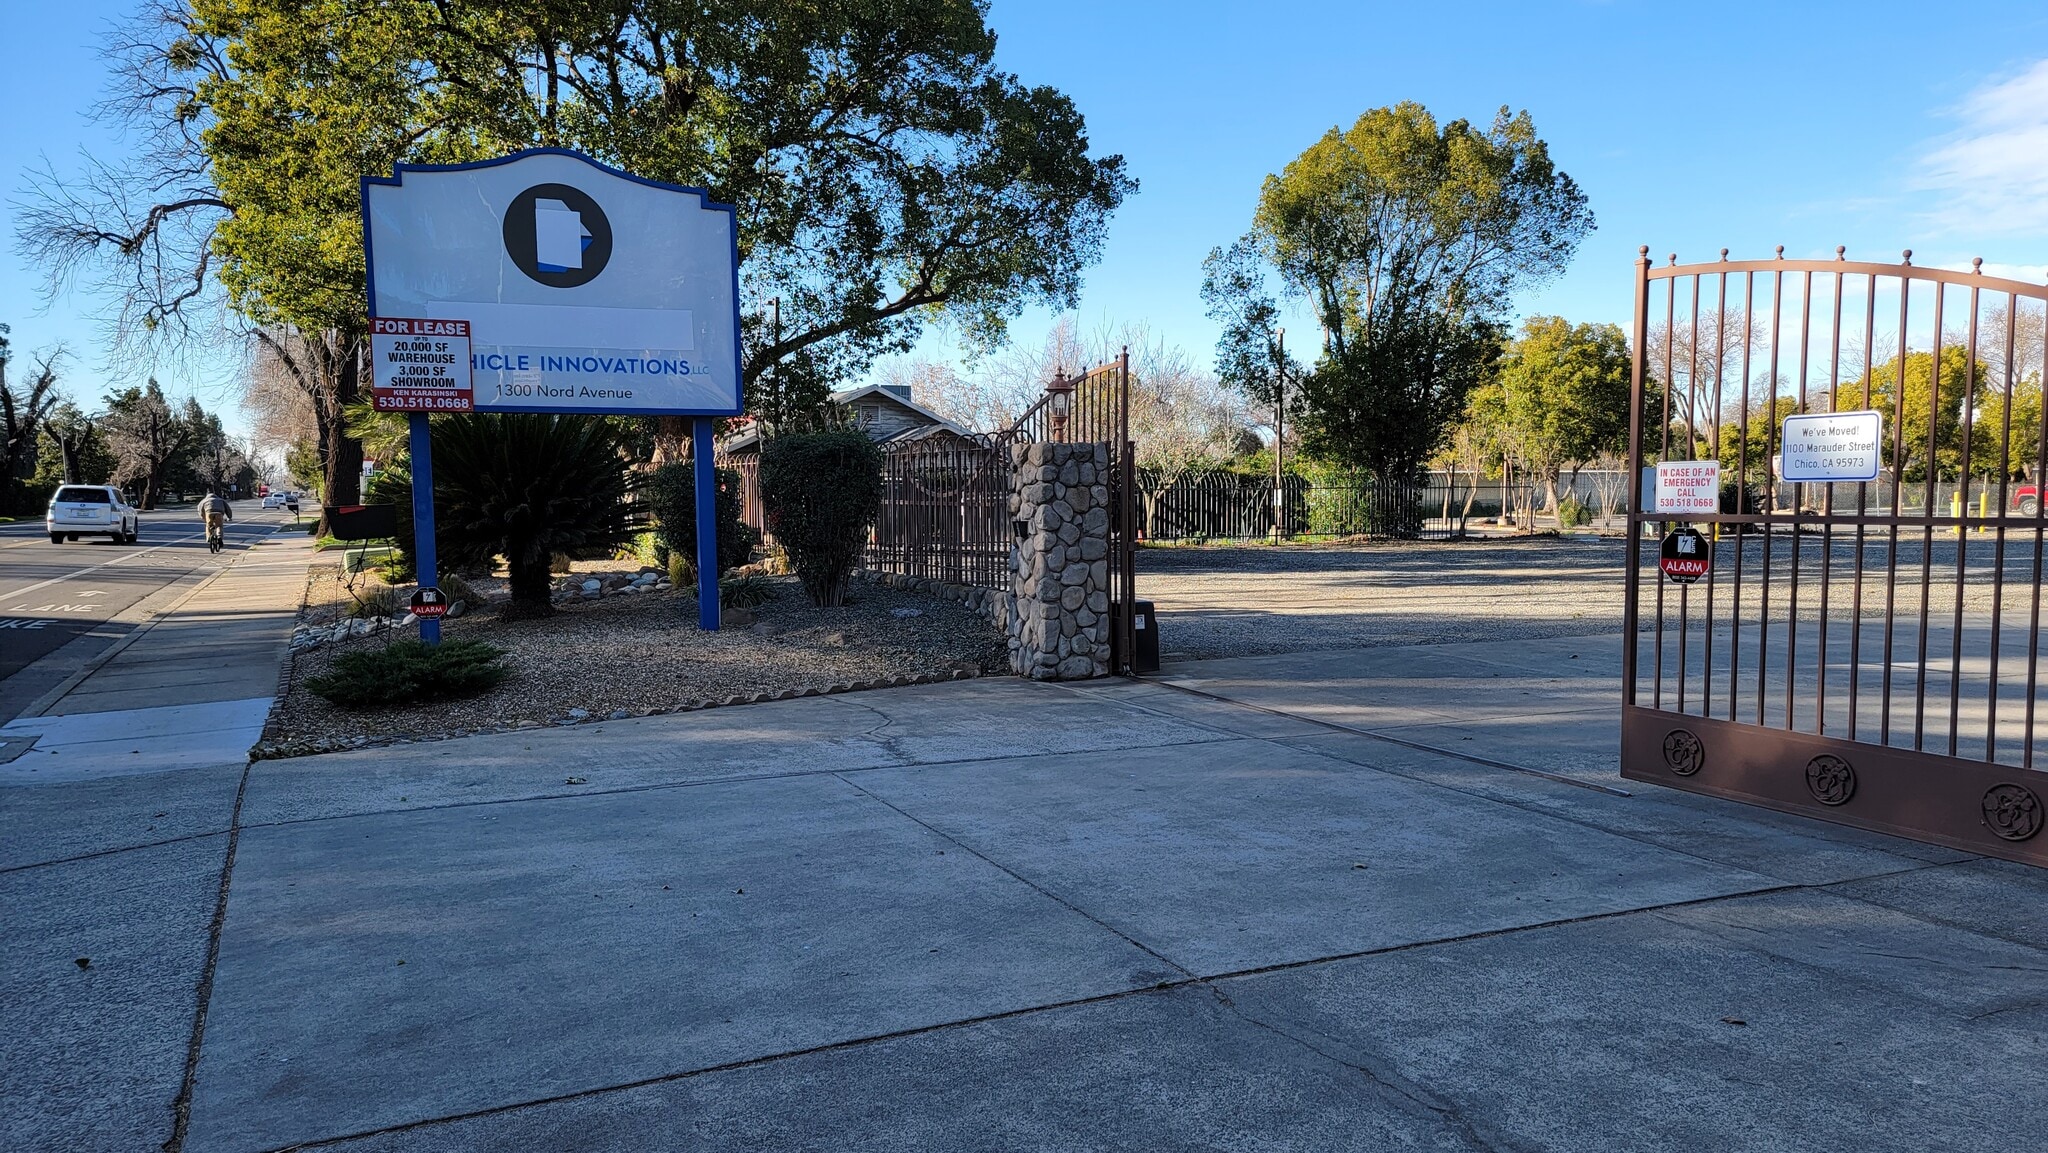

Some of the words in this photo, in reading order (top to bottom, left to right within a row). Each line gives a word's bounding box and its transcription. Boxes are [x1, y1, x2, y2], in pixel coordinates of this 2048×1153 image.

[375, 320, 409, 333] FOR
[414, 322, 466, 335] LEASE
[394, 341, 432, 352] 20,000
[435, 342, 448, 352] SF
[388, 352, 456, 364] WAREHOUSE
[399, 365, 430, 376] 3,000
[433, 366, 446, 376] SF
[391, 376, 455, 388] SHOWROOM
[495, 384, 532, 397] 1300
[537, 385, 574, 398] Nord
[579, 386, 633, 399] Avenue
[379, 396, 469, 408] 530.518.0668
[1802, 427, 1826, 437] We've
[1829, 425, 1859, 436] Moved!
[1786, 444, 1804, 453] 1100
[1807, 442, 1846, 453] Marauder
[1848, 441, 1875, 451] Street
[1822, 459, 1834, 468] CA
[1836, 458, 1864, 468] 95973
[1660, 469, 1668, 477] IN
[1670, 468, 1690, 477] CASE
[1692, 468, 1702, 477] OF
[1705, 468, 1716, 476] AN
[1664, 478, 1711, 487] EMERGENCY
[1677, 488, 1696, 497] CALL
[1660, 498, 1675, 507] 530
[1676, 498, 1691, 507] 518
[1693, 498, 1714, 507] 0668
[1666, 560, 1703, 573] ALARM
[7, 603, 103, 612] LANE
[415, 606, 443, 614] ALARM
